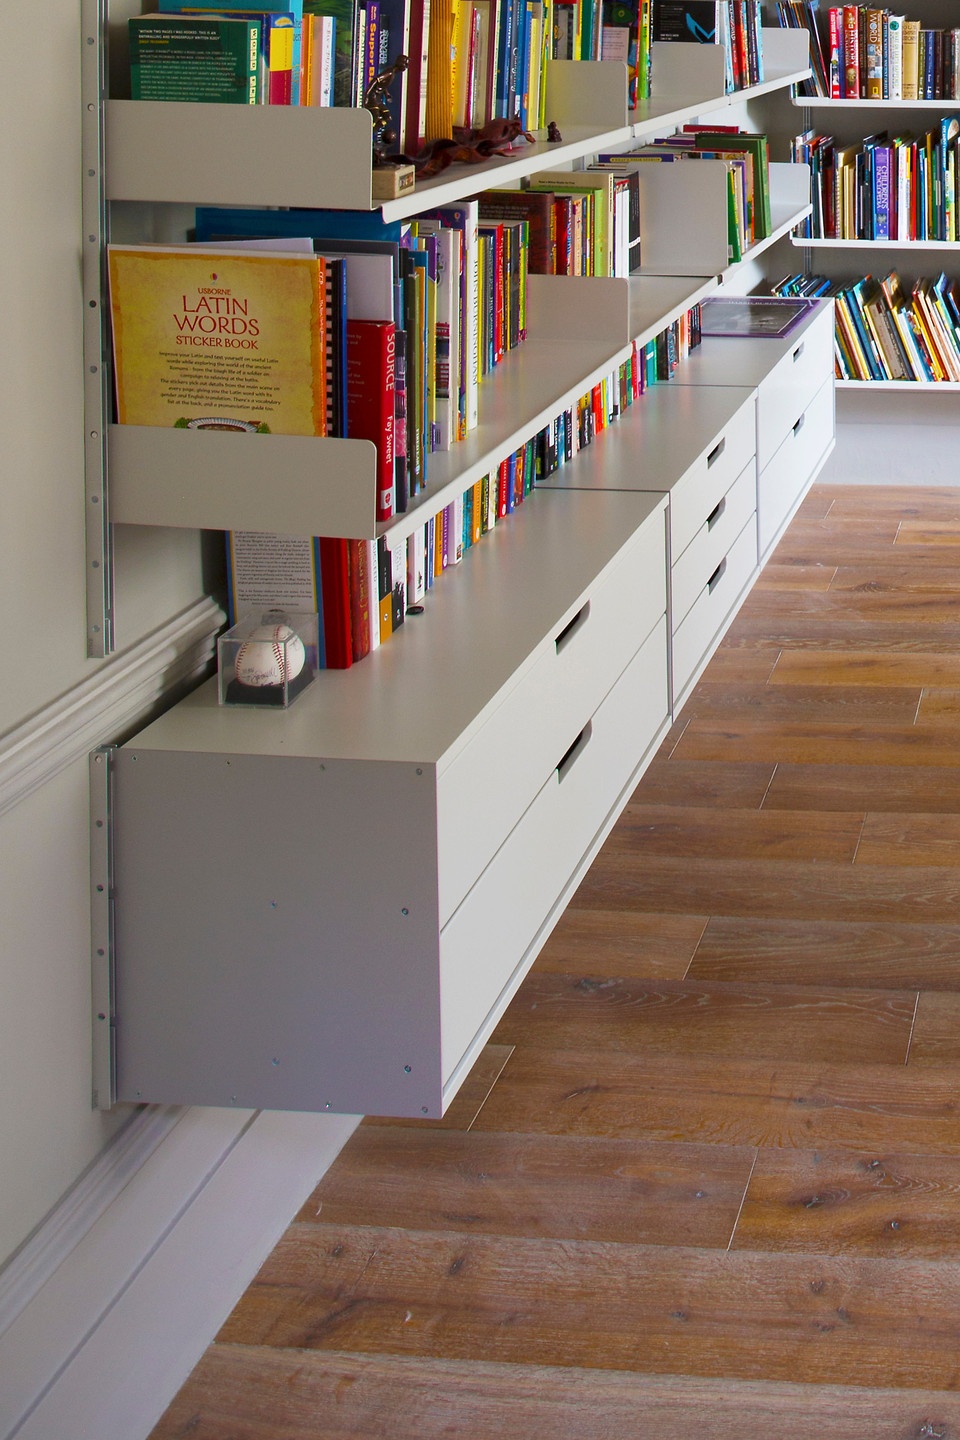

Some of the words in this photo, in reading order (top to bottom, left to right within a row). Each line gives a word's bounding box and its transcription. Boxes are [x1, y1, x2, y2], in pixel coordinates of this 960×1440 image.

[869, 13, 877, 43] WORLD
[368, 23, 377, 66] Super
[197, 287, 232, 296] USBORNE
[182, 295, 248, 316] LATIN
[172, 314, 260, 337] WORDS
[175, 335, 223, 348] STICKER
[224, 338, 259, 350] BOOK
[385, 333, 395, 392] SOURCE
[385, 415, 394, 433] Fay
[385, 433, 393, 464] Sweet
